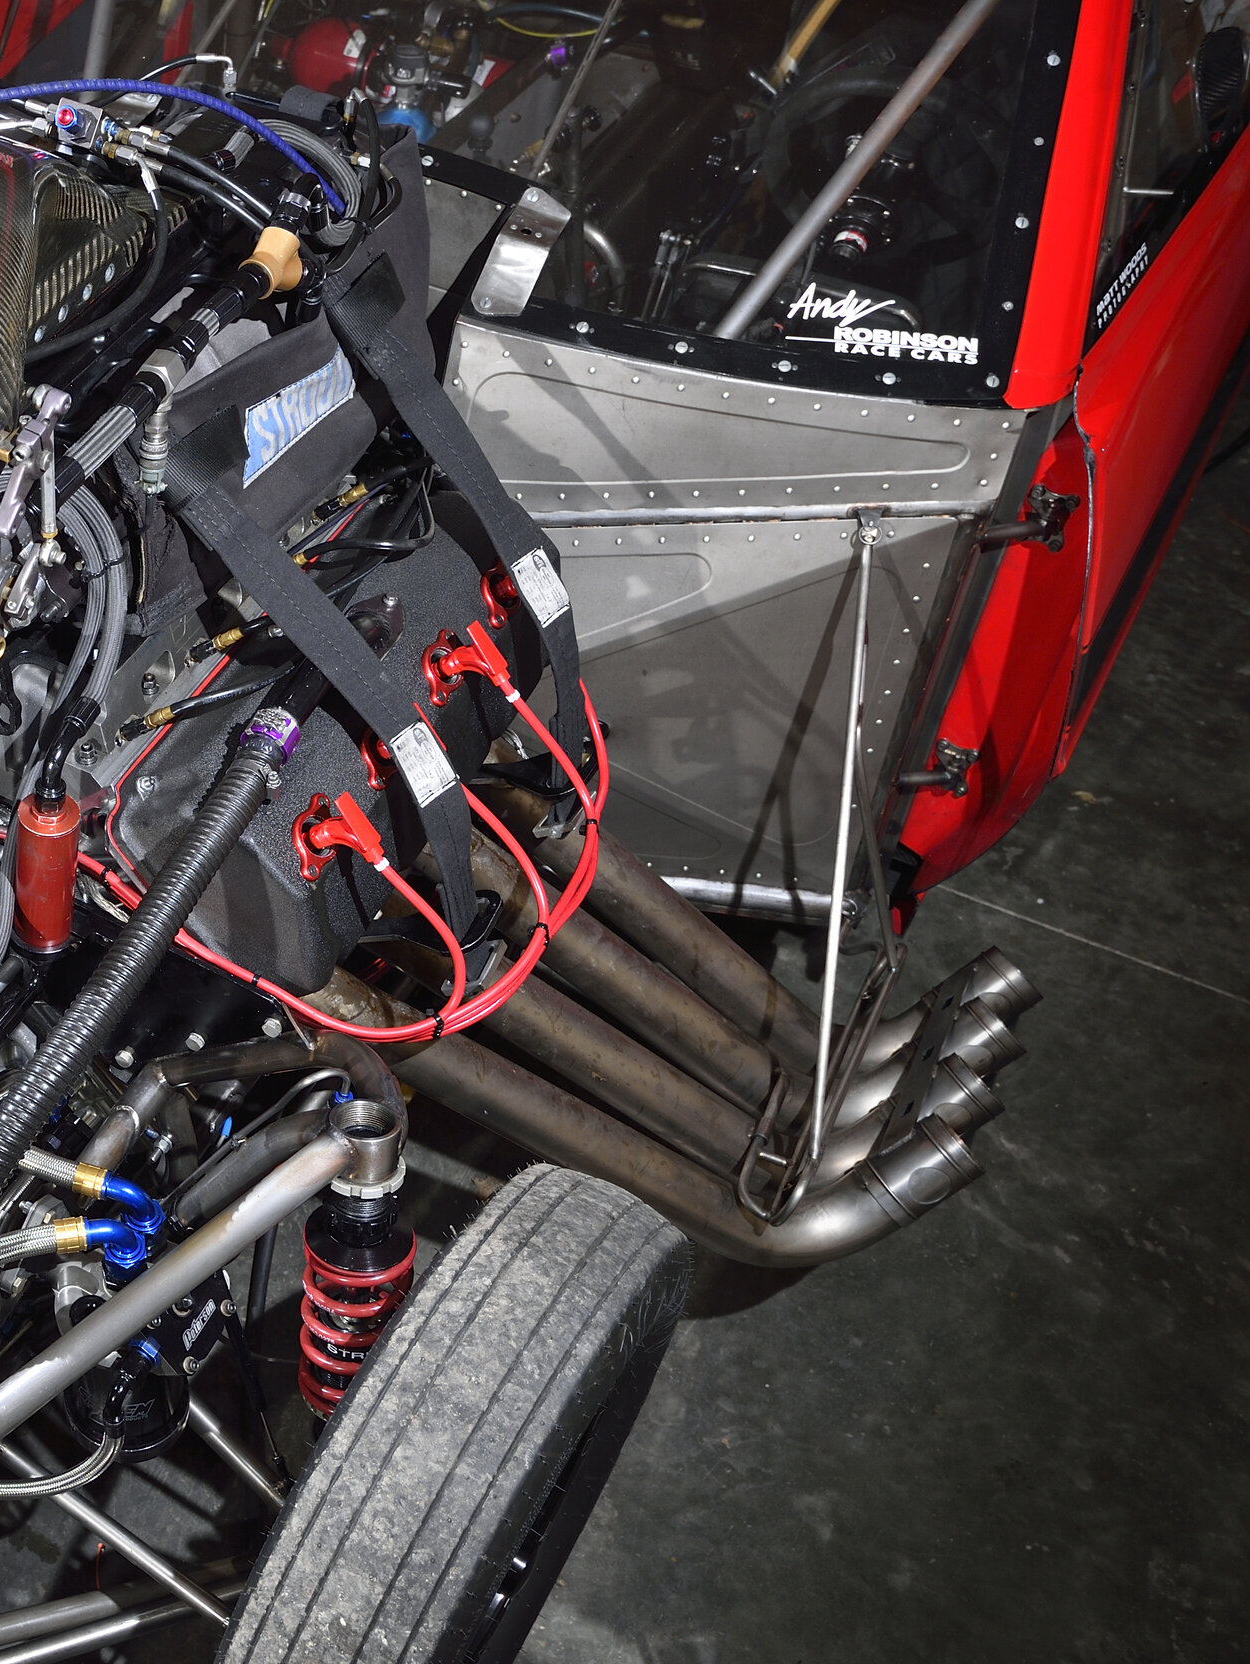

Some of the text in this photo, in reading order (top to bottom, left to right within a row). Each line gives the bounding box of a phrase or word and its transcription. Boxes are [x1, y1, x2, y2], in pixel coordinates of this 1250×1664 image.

[1119, 242, 1147, 284] WOODS
[787, 282, 896, 327] Andy
[833, 325, 979, 353] ROBINSON
[833, 343, 978, 365] RACE CARS
[326, 1342, 369, 1360] STR
